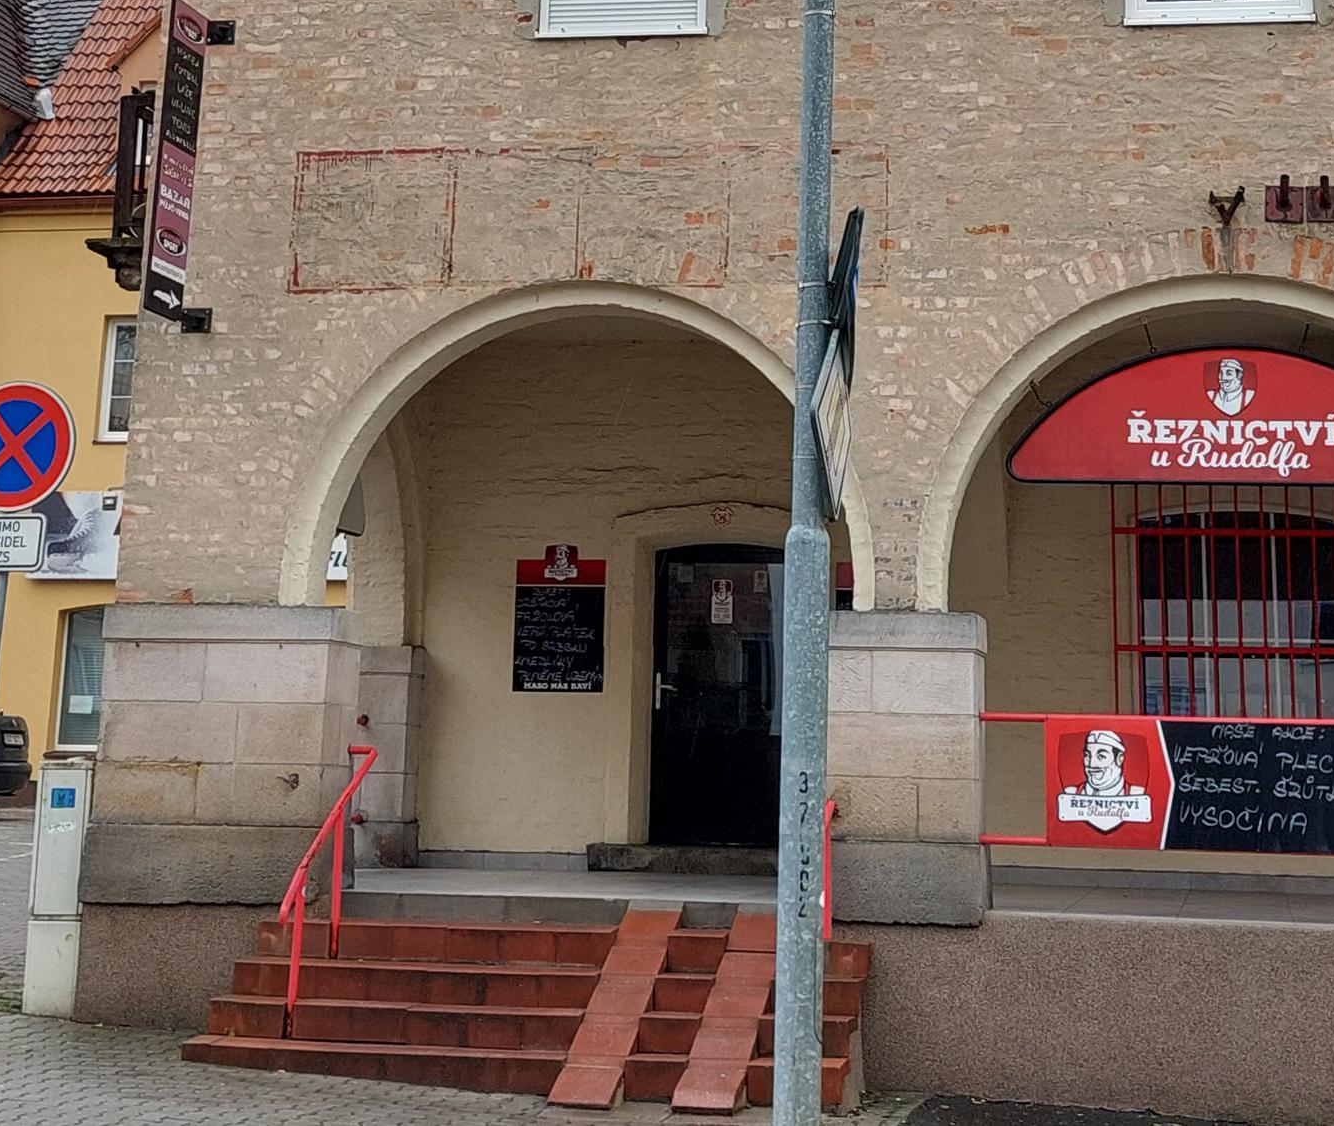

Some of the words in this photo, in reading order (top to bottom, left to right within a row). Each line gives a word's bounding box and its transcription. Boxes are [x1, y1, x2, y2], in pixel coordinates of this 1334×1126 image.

[160, 183, 191, 211] BAZAR
[1151, 447, 1171, 468] u
[1177, 437, 1311, 477] Rudolfa
[524, 682, 548, 690] MASO
[550, 681, 568, 690] NÁS
[571, 681, 592, 690] BAVÍ
[1211, 724, 1256, 739] NAŠE
[1174, 742, 1264, 768] VEPŘOVÁ
[1275, 752, 1334, 773] PLEC
[1070, 796, 1140, 809] ŘEZNICTVÍ
[1087, 807, 1130, 820] Rudolfa
